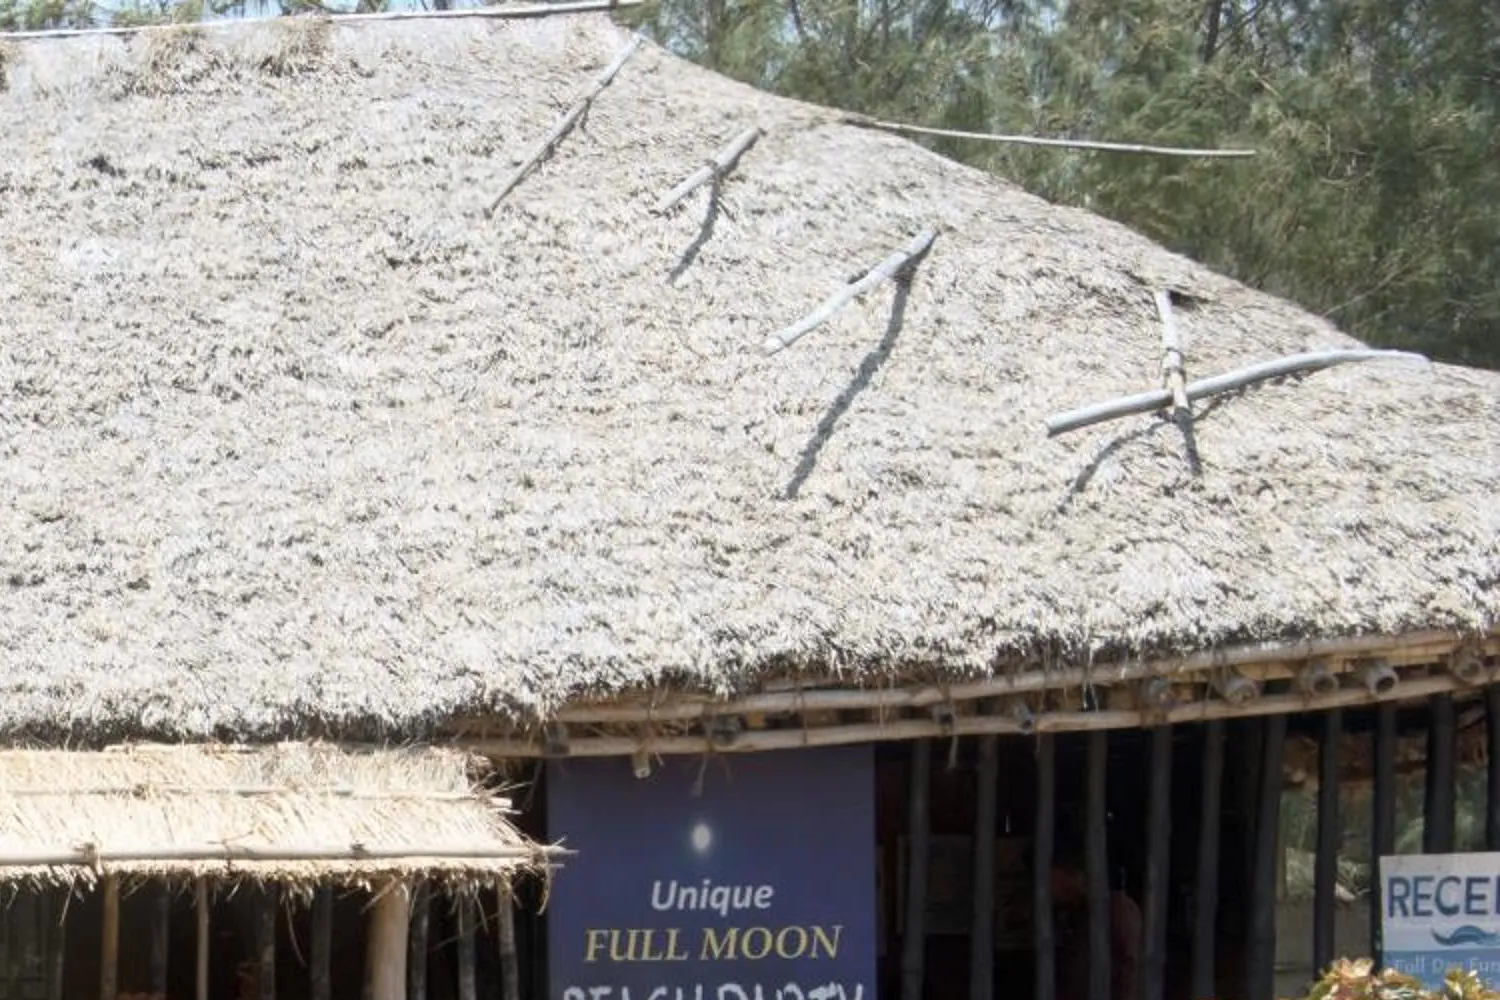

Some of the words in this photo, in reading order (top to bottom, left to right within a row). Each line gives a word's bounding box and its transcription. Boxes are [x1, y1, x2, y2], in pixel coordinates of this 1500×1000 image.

[651, 879, 774, 917] Unique
[584, 928, 689, 962] FULL
[700, 925, 843, 960] MOON
